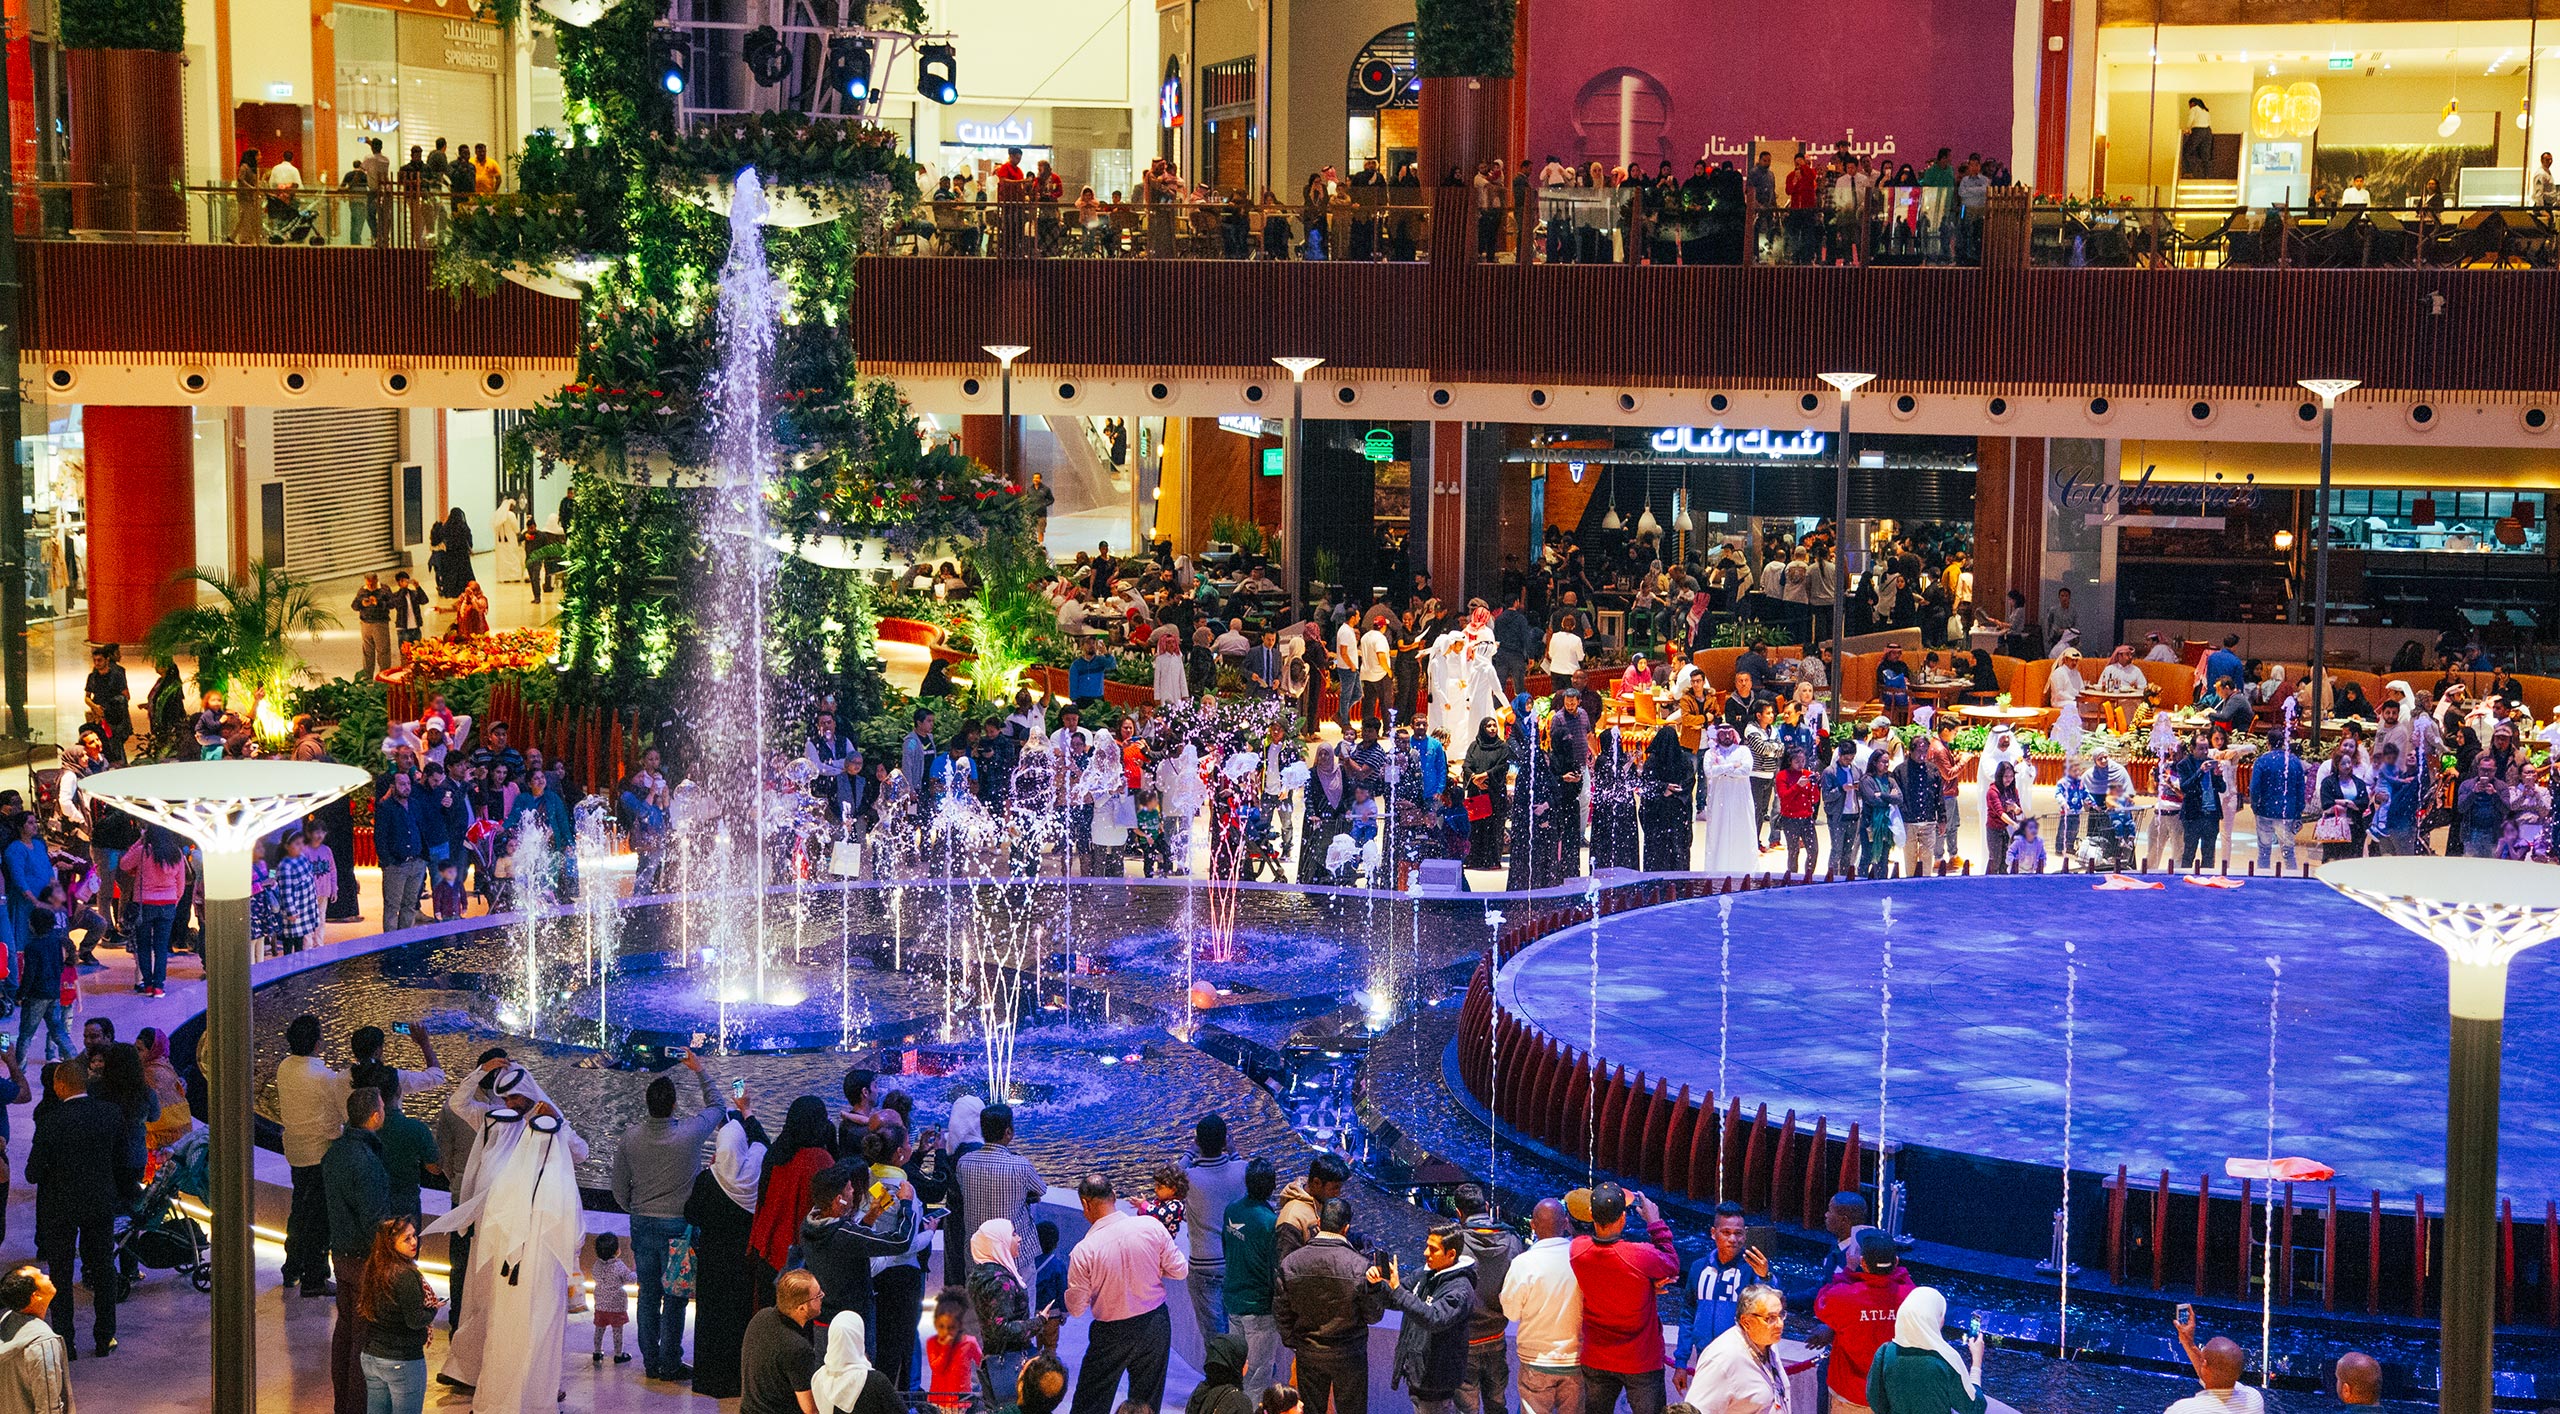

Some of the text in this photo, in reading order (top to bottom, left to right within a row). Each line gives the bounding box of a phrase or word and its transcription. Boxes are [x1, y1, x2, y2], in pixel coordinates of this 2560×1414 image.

[444, 48, 498, 70] SPRINGFIELD
[1652, 424, 1825, 460] شيك شاك
[1524, 449, 1602, 463] BURGERS
[1859, 1309, 1897, 1322] ATLA
